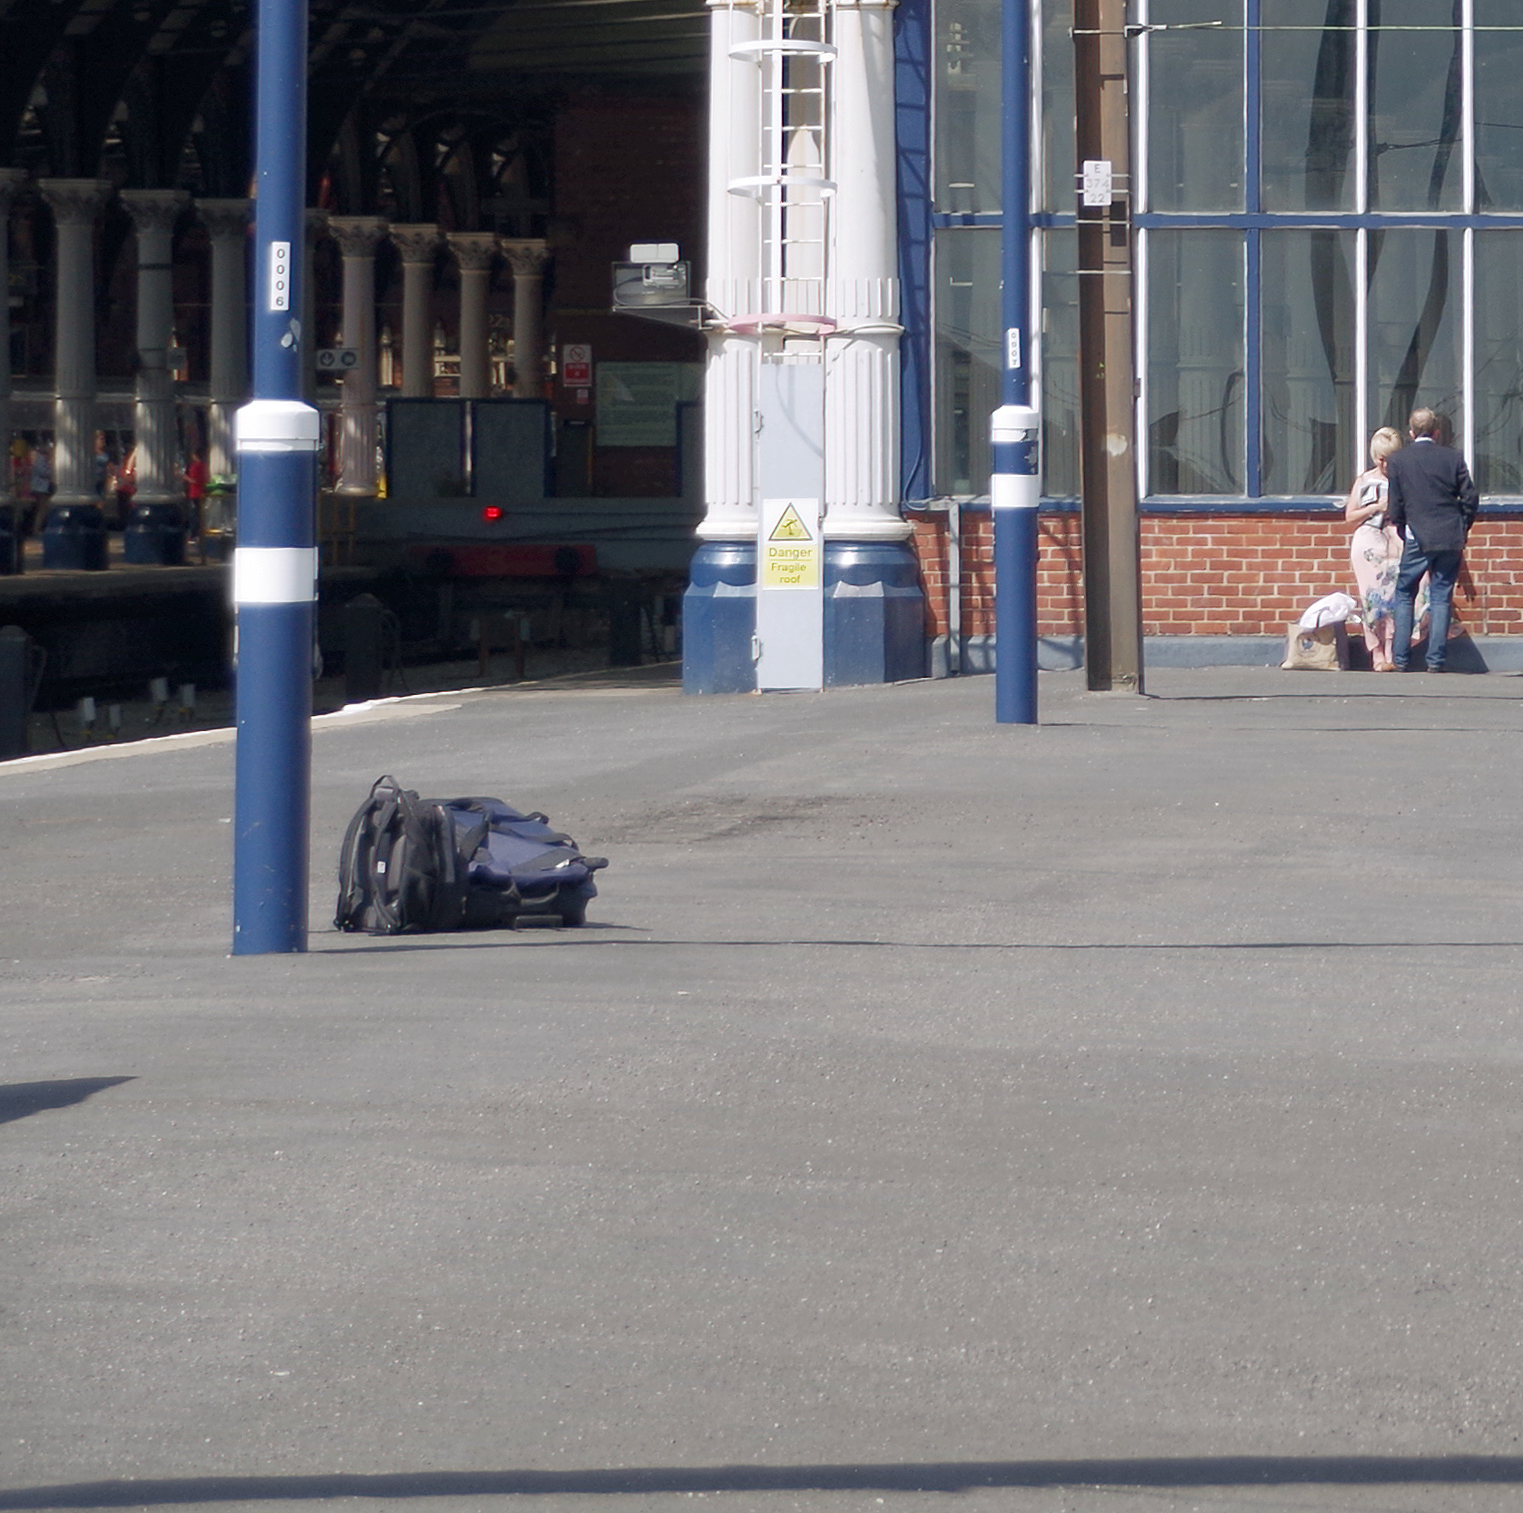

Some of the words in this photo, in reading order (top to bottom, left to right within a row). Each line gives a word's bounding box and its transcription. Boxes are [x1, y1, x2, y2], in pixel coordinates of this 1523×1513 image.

[1094, 164, 1101, 174] E
[1090, 193, 1105, 203] 22
[275, 249, 286, 306] 0006
[769, 547, 813, 559] Danger
[771, 562, 807, 573] Fragile
[779, 574, 801, 583] roof
